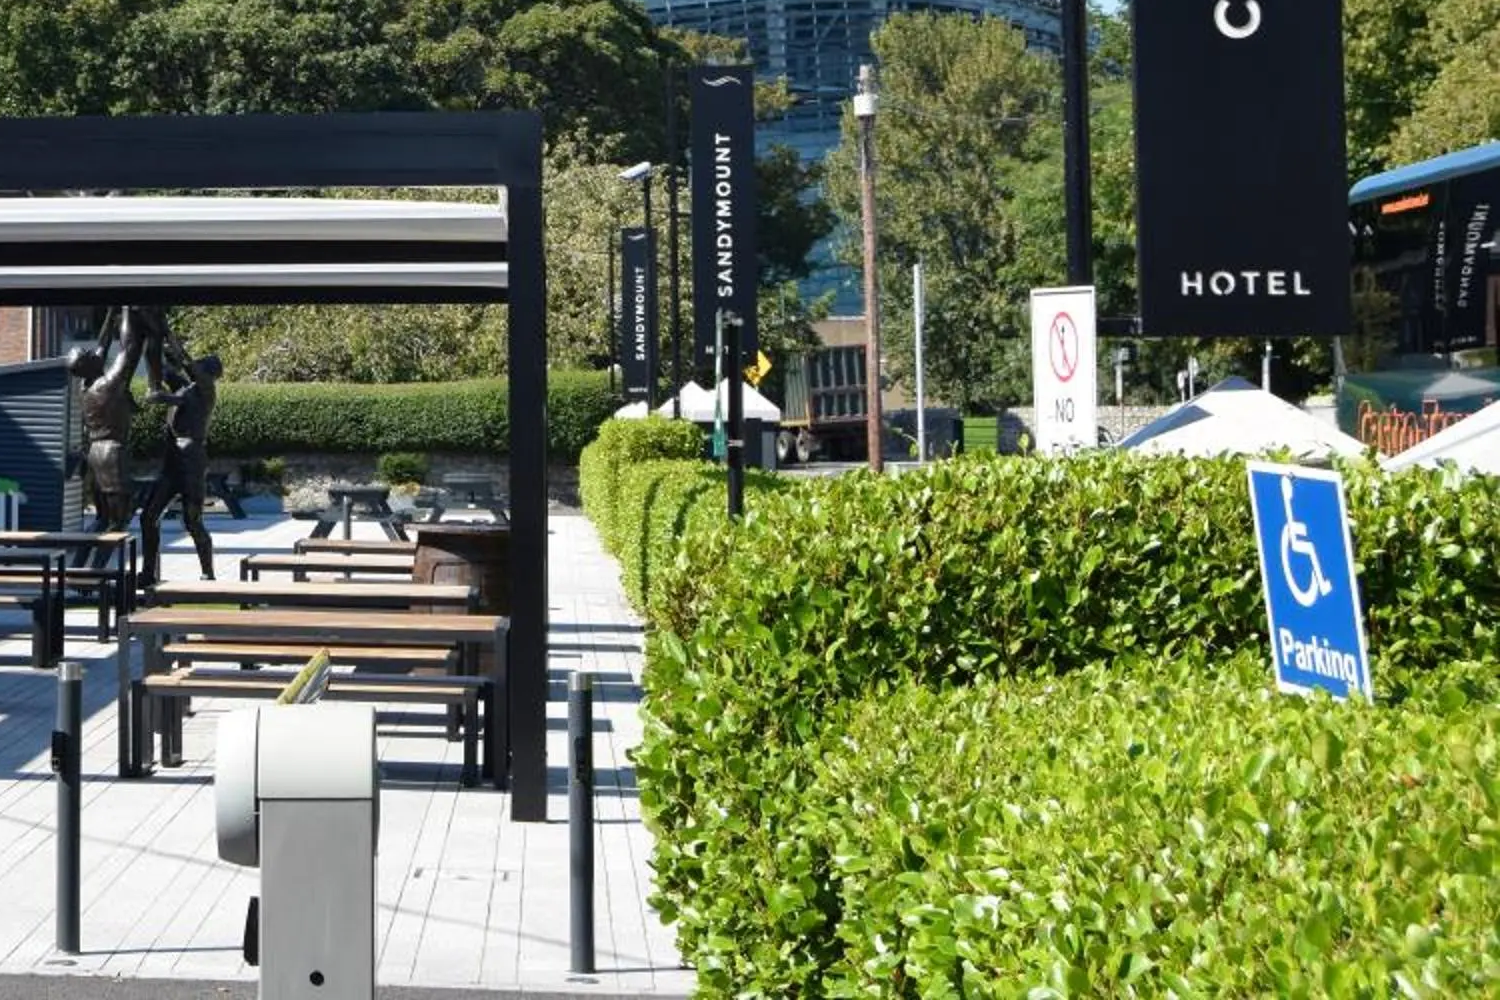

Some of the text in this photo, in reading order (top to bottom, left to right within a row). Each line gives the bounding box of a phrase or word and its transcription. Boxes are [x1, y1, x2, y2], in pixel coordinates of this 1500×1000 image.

[714, 132, 734, 297] SANDYMOUNT
[634, 266, 647, 361] SANDYMOUNT
[1181, 271, 1311, 296] HOTEL
[1054, 397, 1075, 423] NO
[1279, 627, 1357, 690] Parking
